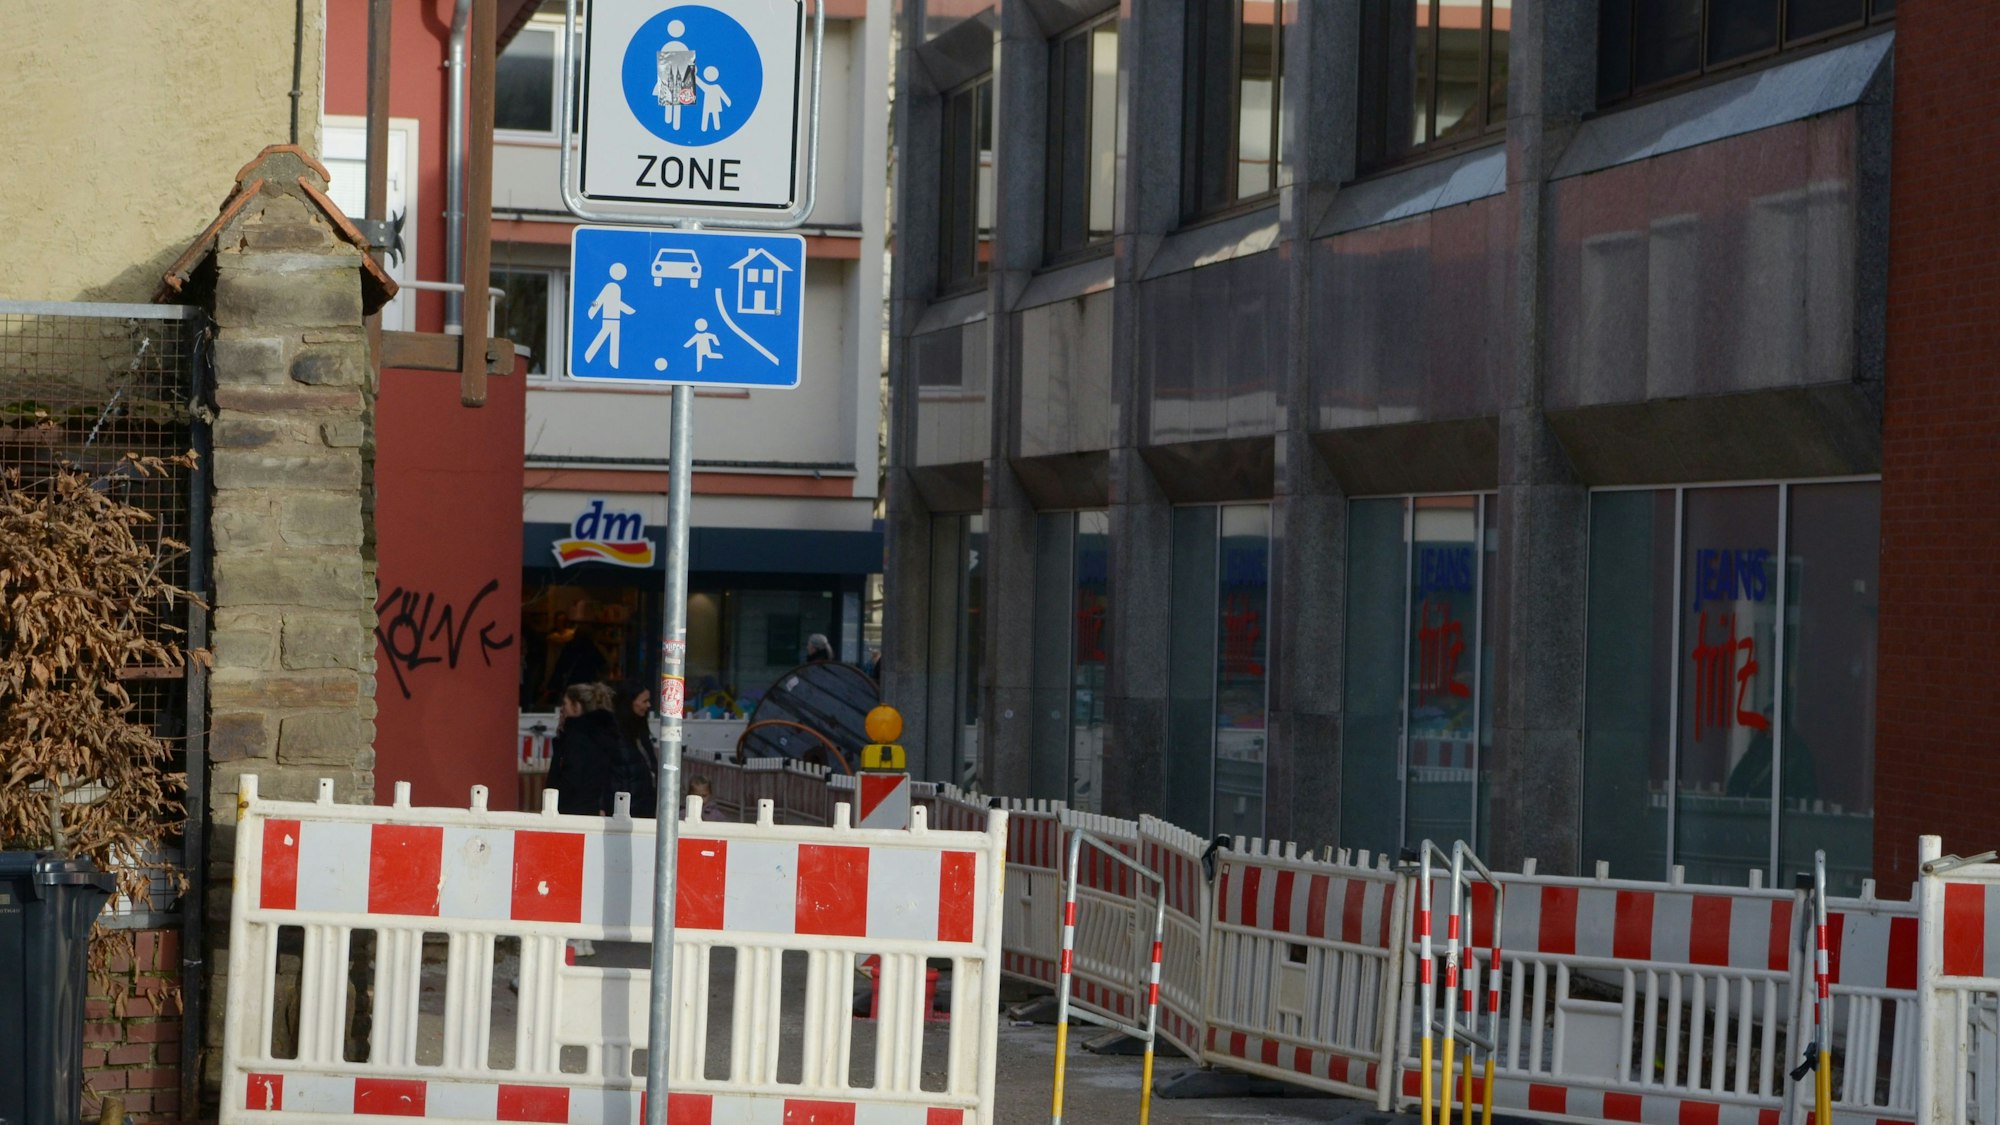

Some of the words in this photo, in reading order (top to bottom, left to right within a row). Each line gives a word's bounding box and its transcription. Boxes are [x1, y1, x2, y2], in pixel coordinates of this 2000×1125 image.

[636, 155, 741, 191] ZONE
[575, 501, 642, 541] dm
[1419, 547, 1473, 601] JEANS
[1693, 548, 1770, 613] JEANS
[1691, 609, 1769, 744] fritz
